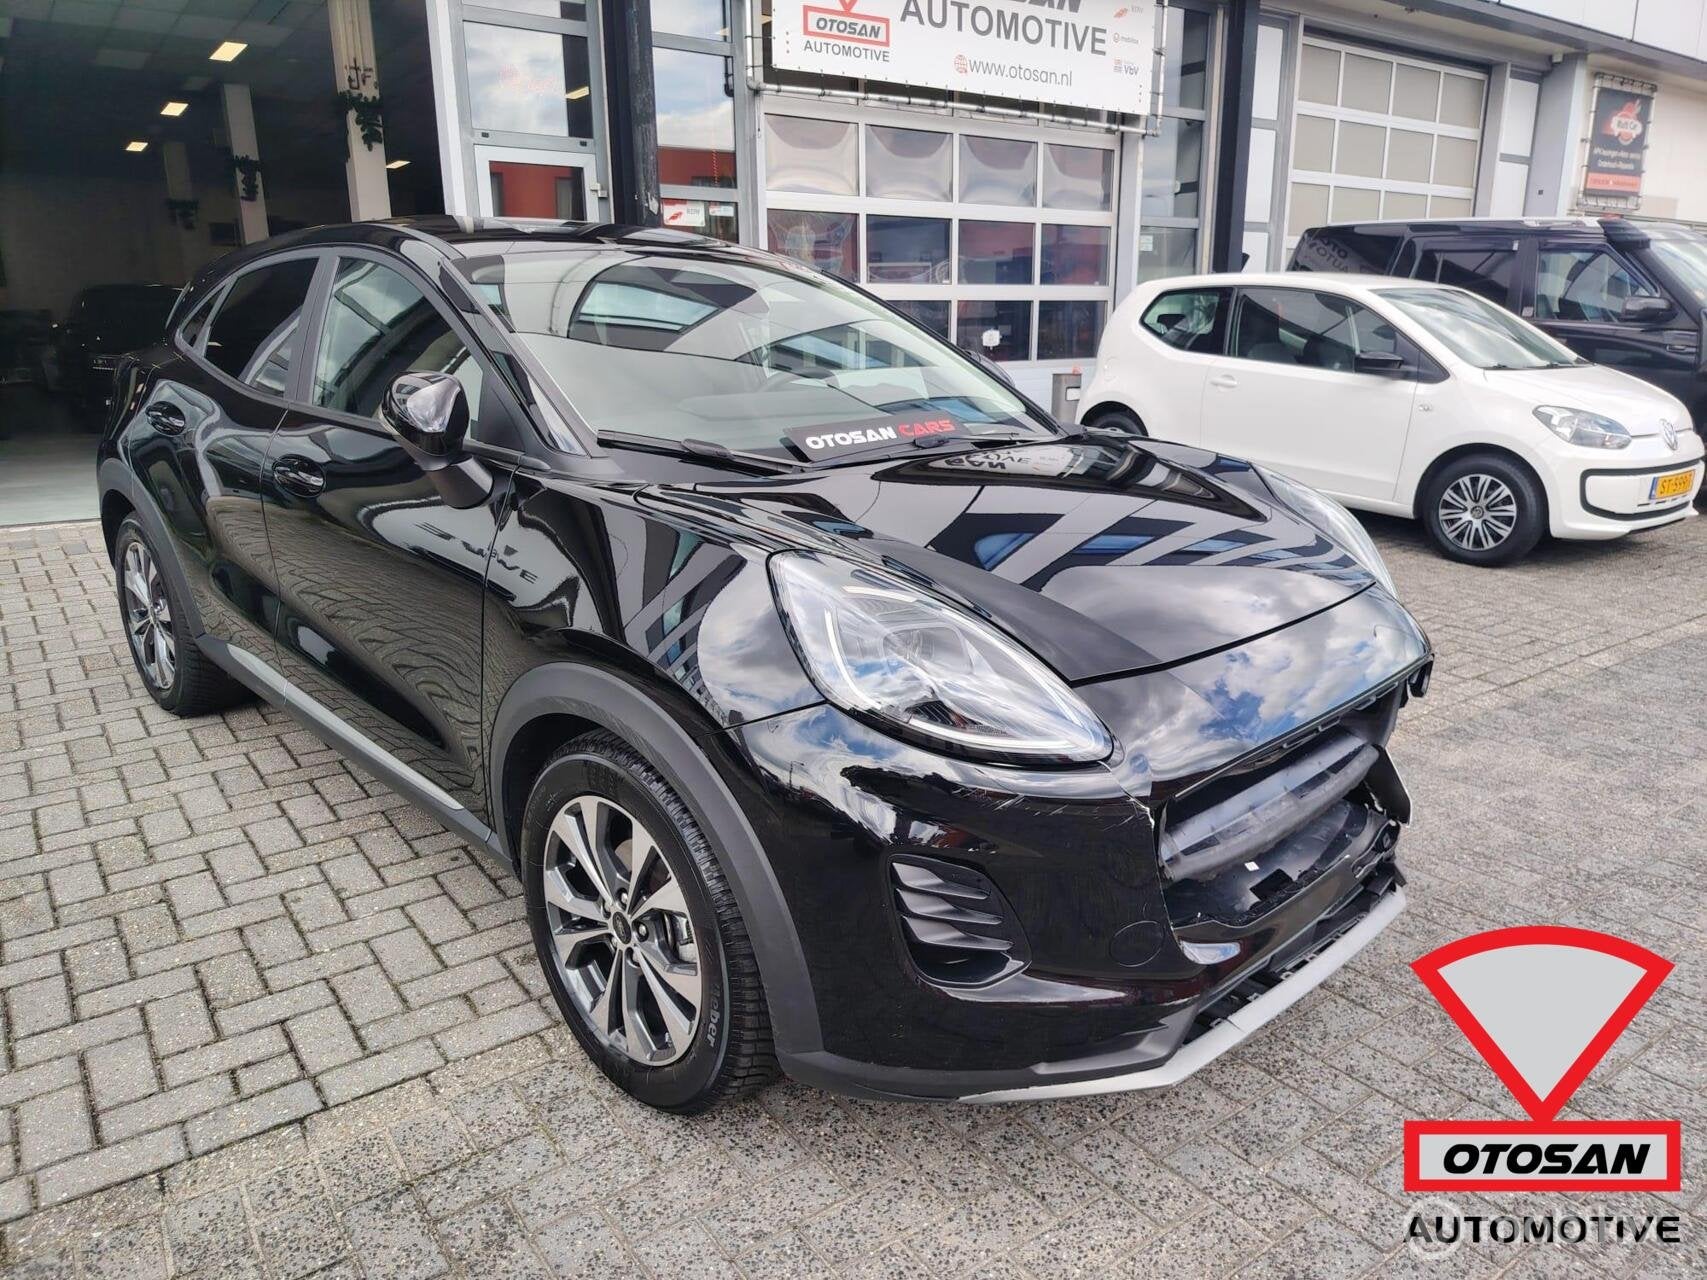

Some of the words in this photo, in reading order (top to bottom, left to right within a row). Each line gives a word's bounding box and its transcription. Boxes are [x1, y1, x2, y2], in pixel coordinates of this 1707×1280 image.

[816, 17, 881, 39] OTOSAN
[900, 0, 1107, 56] AUTOMOTIVE
[804, 40, 890, 63] AUTOMOTIVE
[969, 58, 1073, 87] www.otosan.nl
[806, 426, 897, 450] OTOSAN
[898, 419, 956, 437] CARS
